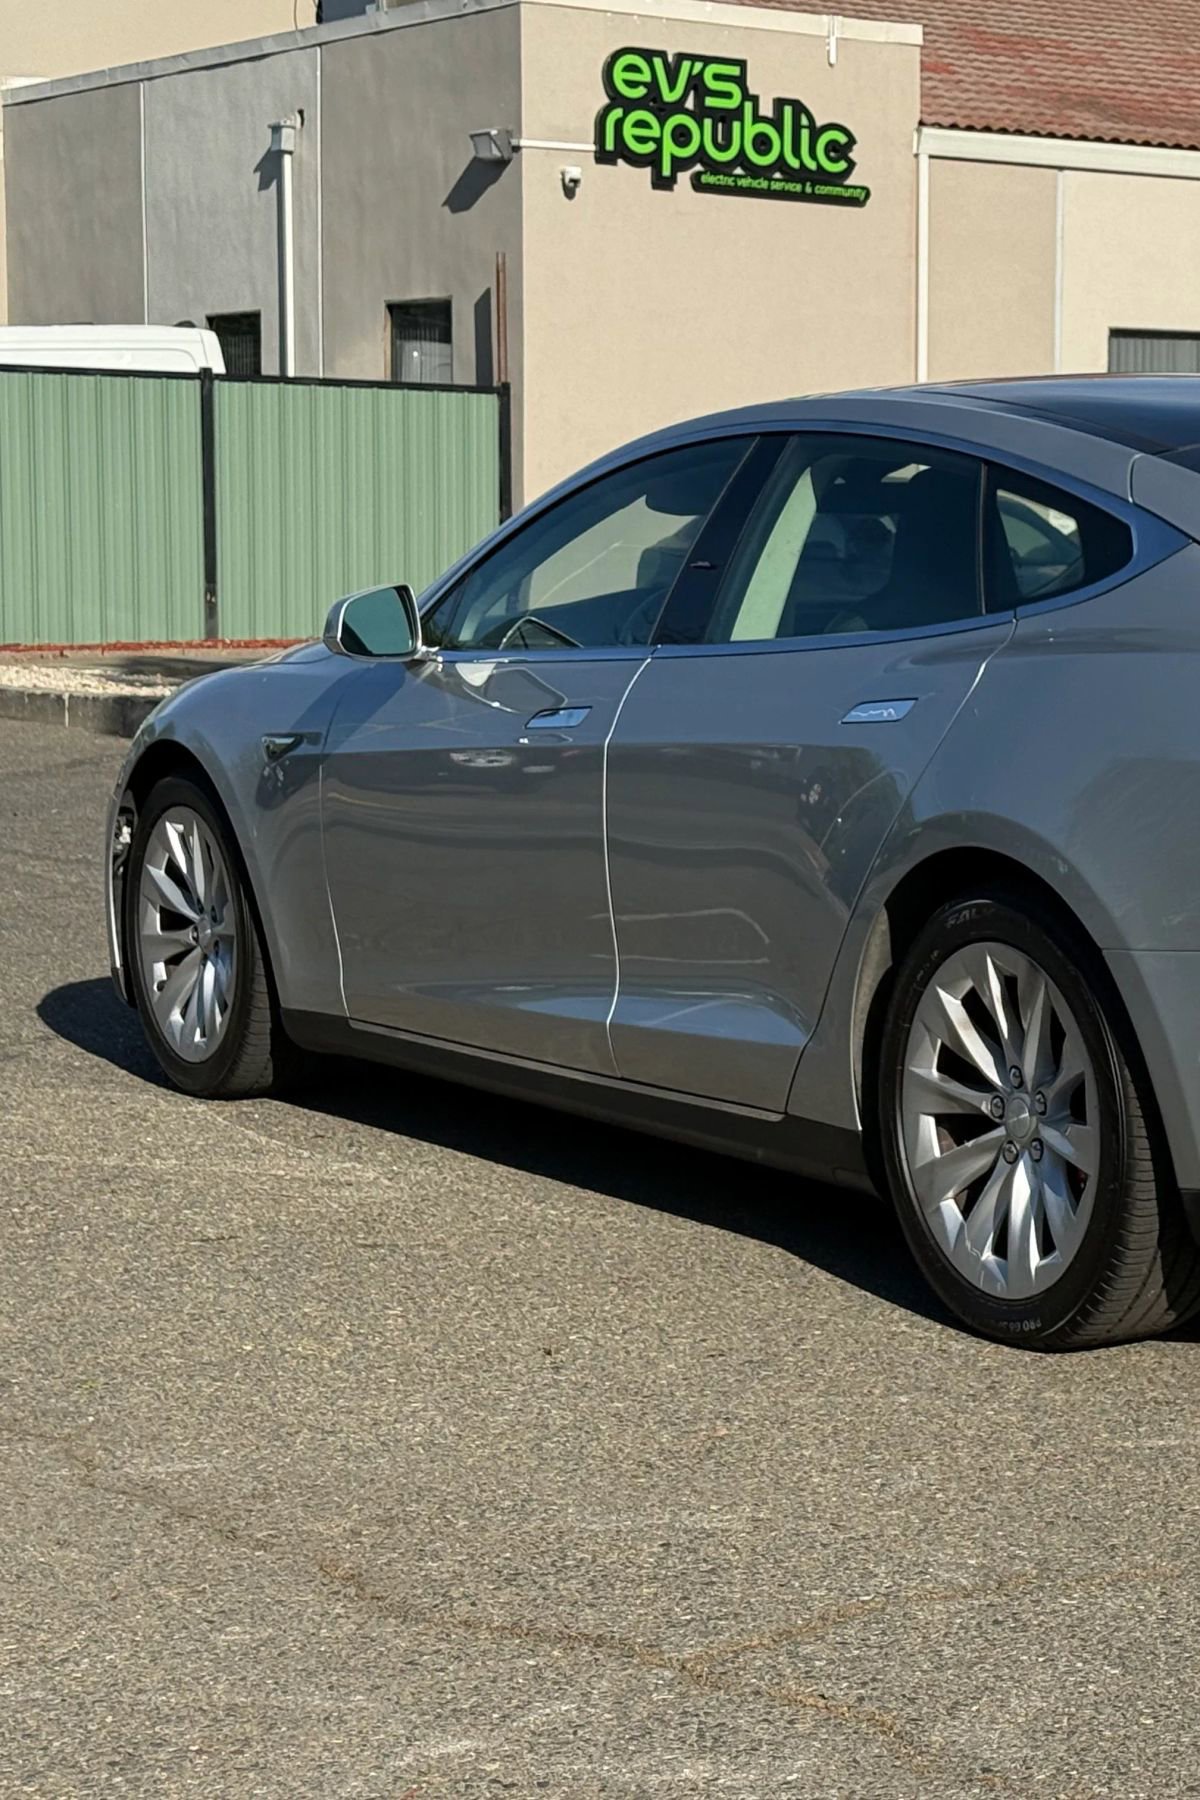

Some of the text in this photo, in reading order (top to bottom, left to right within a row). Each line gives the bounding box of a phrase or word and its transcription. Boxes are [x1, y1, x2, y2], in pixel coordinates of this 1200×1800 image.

[604, 100, 850, 177] republic
[700, 172, 868, 201] electric vehicle service & community
